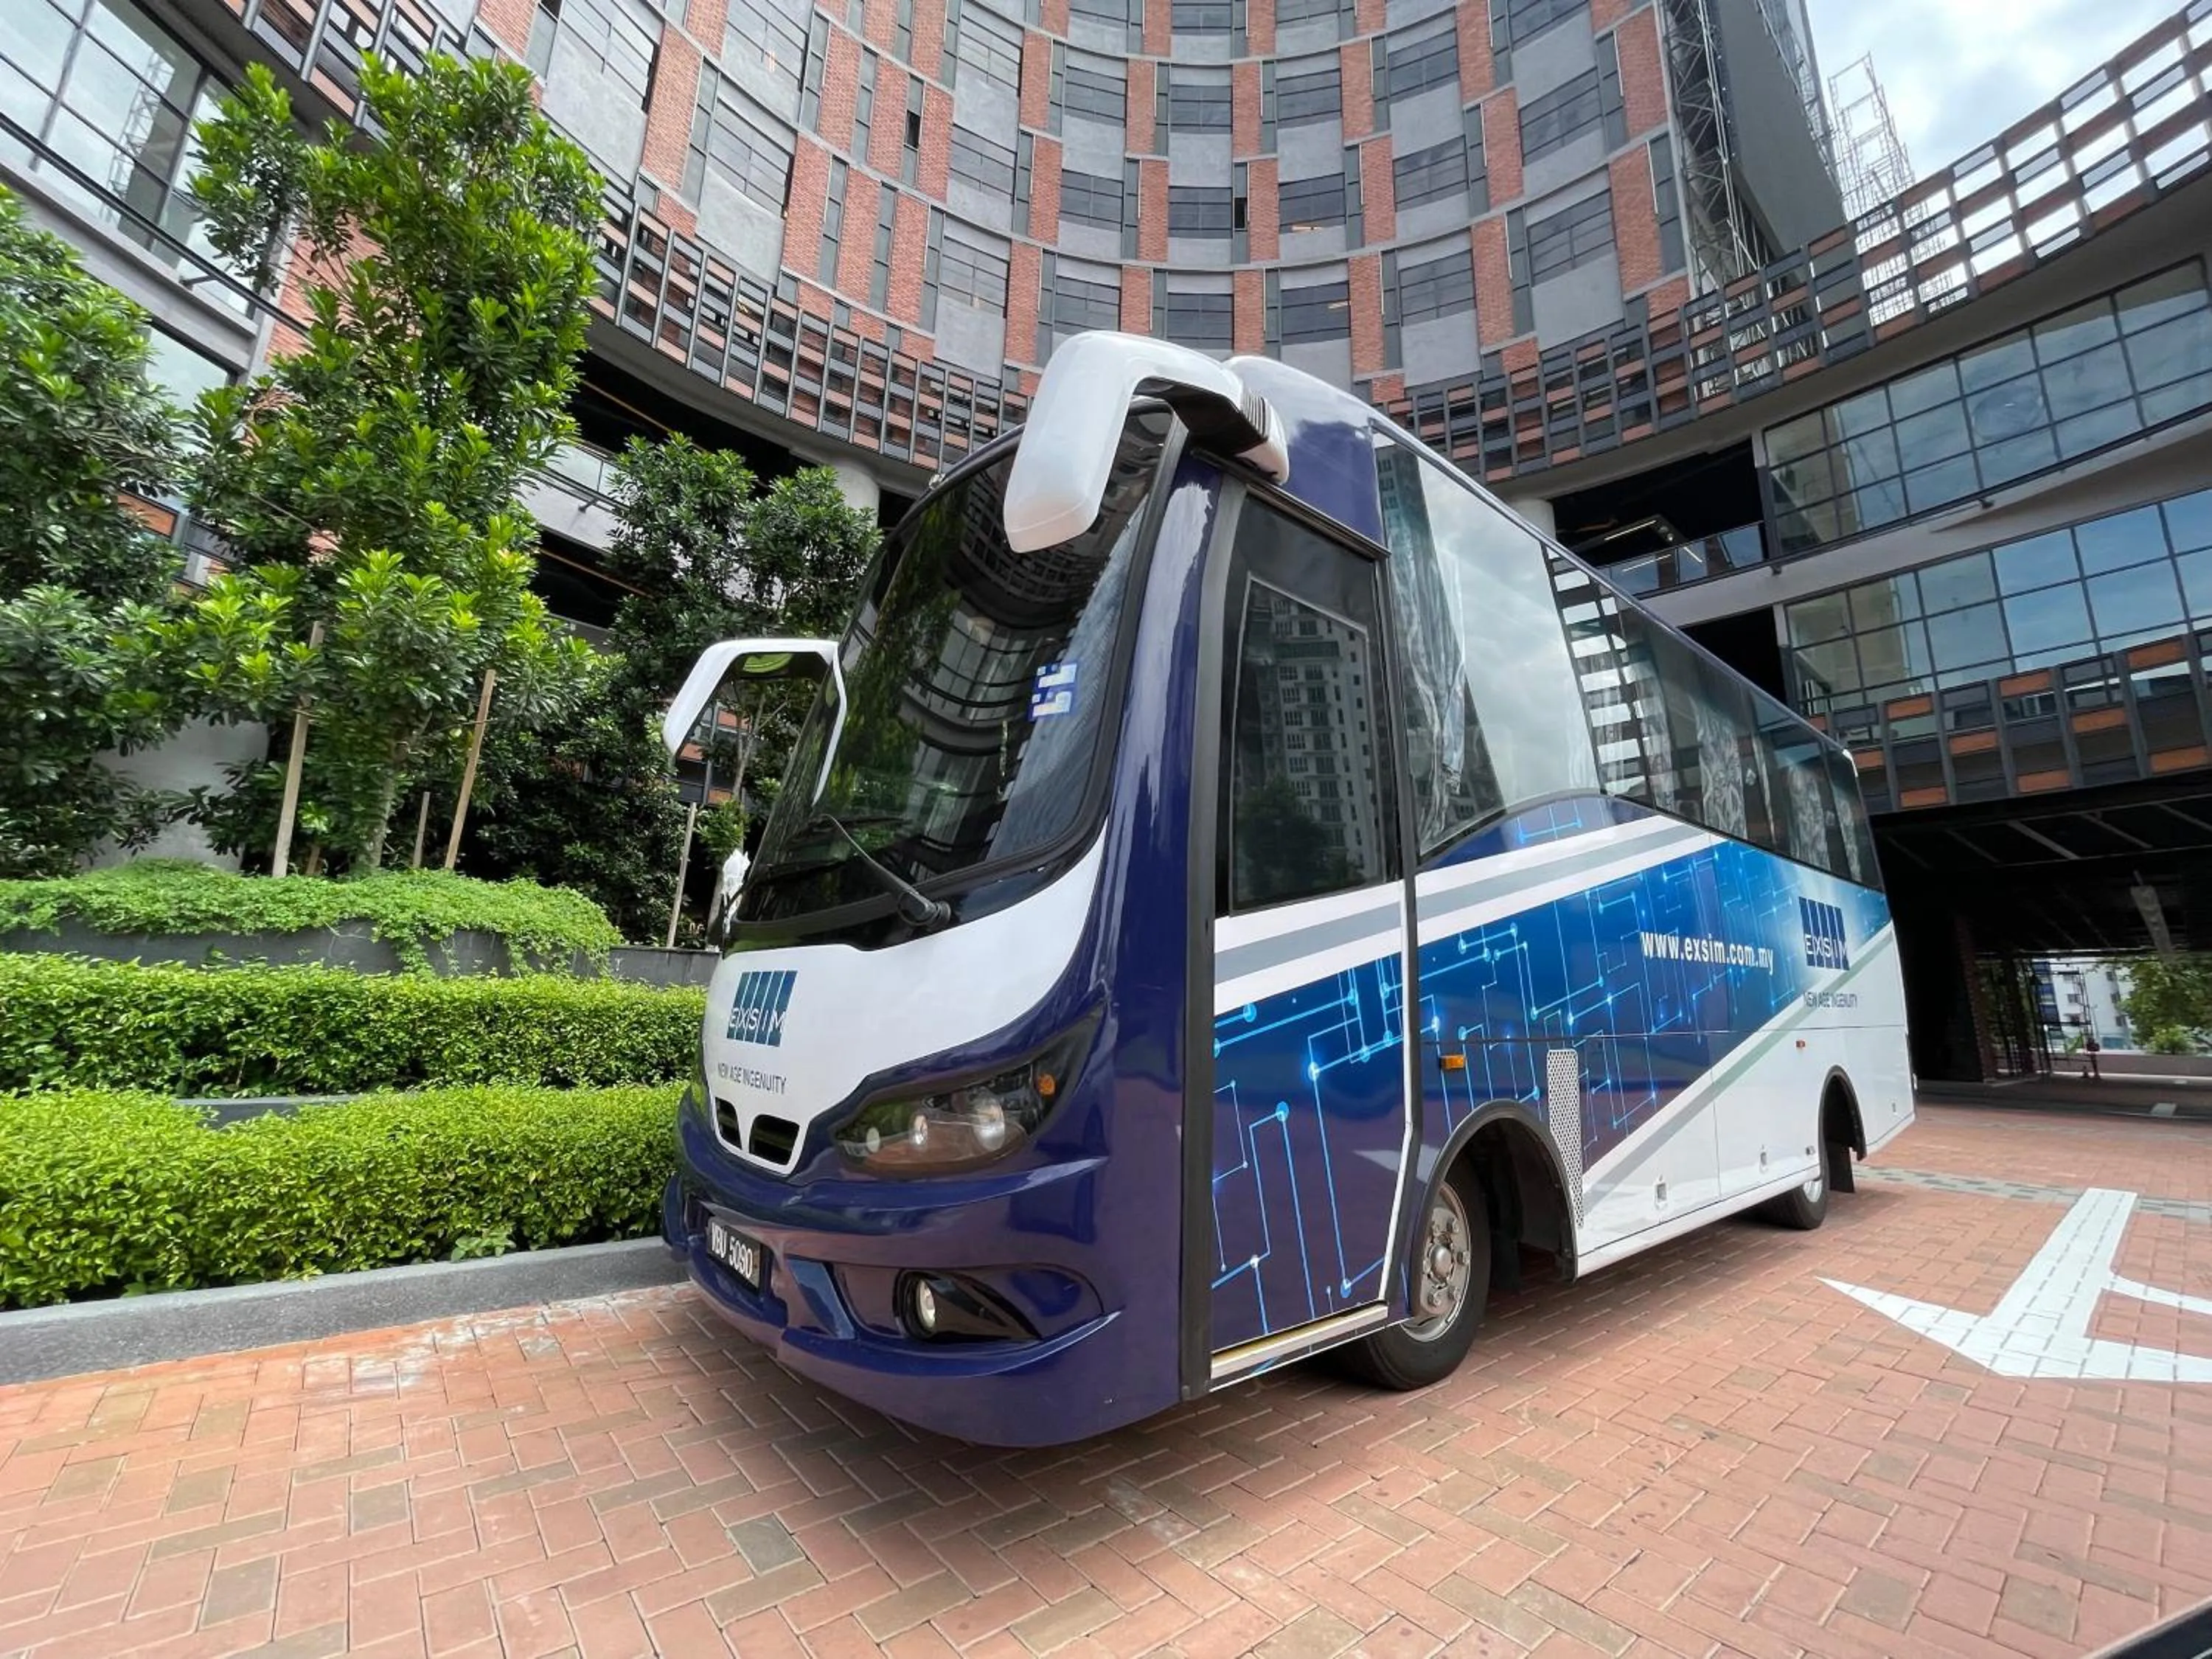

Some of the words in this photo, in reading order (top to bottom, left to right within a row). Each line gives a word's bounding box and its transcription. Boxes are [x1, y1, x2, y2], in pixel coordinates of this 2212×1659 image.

[1640, 931, 1774, 975] www.exsim.com.my
[1805, 933, 1847, 958] EXSIM
[728, 1006, 786, 1034] EXSIM
[742, 1068, 787, 1094] INGENUITY
